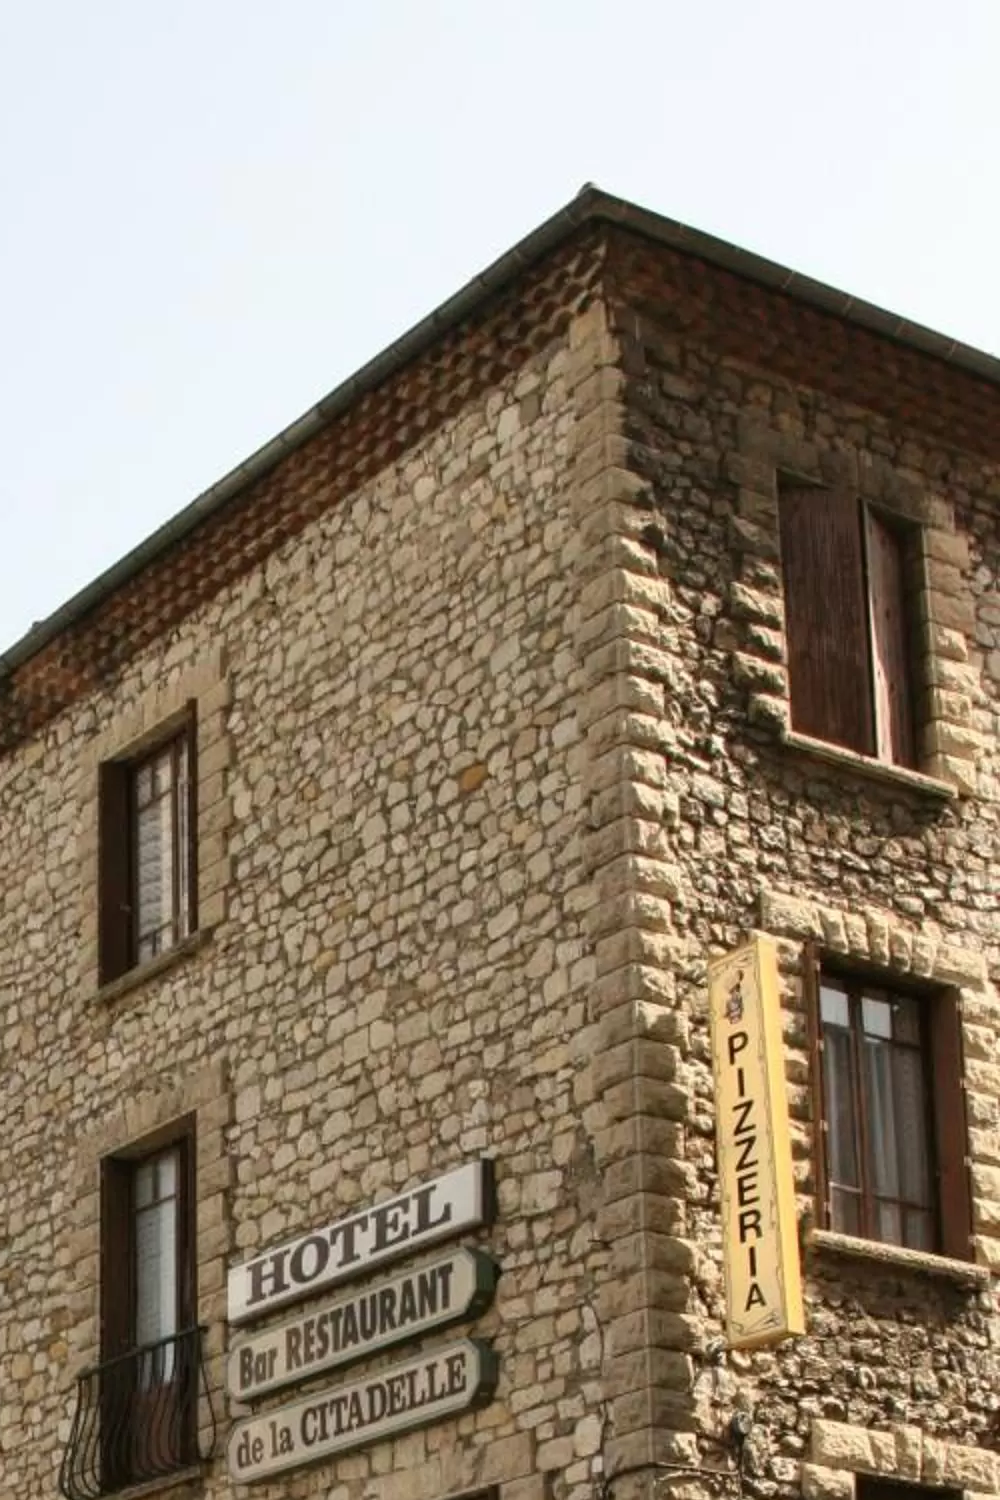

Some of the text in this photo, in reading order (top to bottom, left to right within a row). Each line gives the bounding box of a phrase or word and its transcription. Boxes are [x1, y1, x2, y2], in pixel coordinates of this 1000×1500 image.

[727, 1031, 767, 1312] PIZZERIA
[246, 1184, 451, 1306] HOTEL
[239, 1263, 454, 1390] Bar RESTAURANT
[237, 1352, 467, 1469] de la CITADELLE
